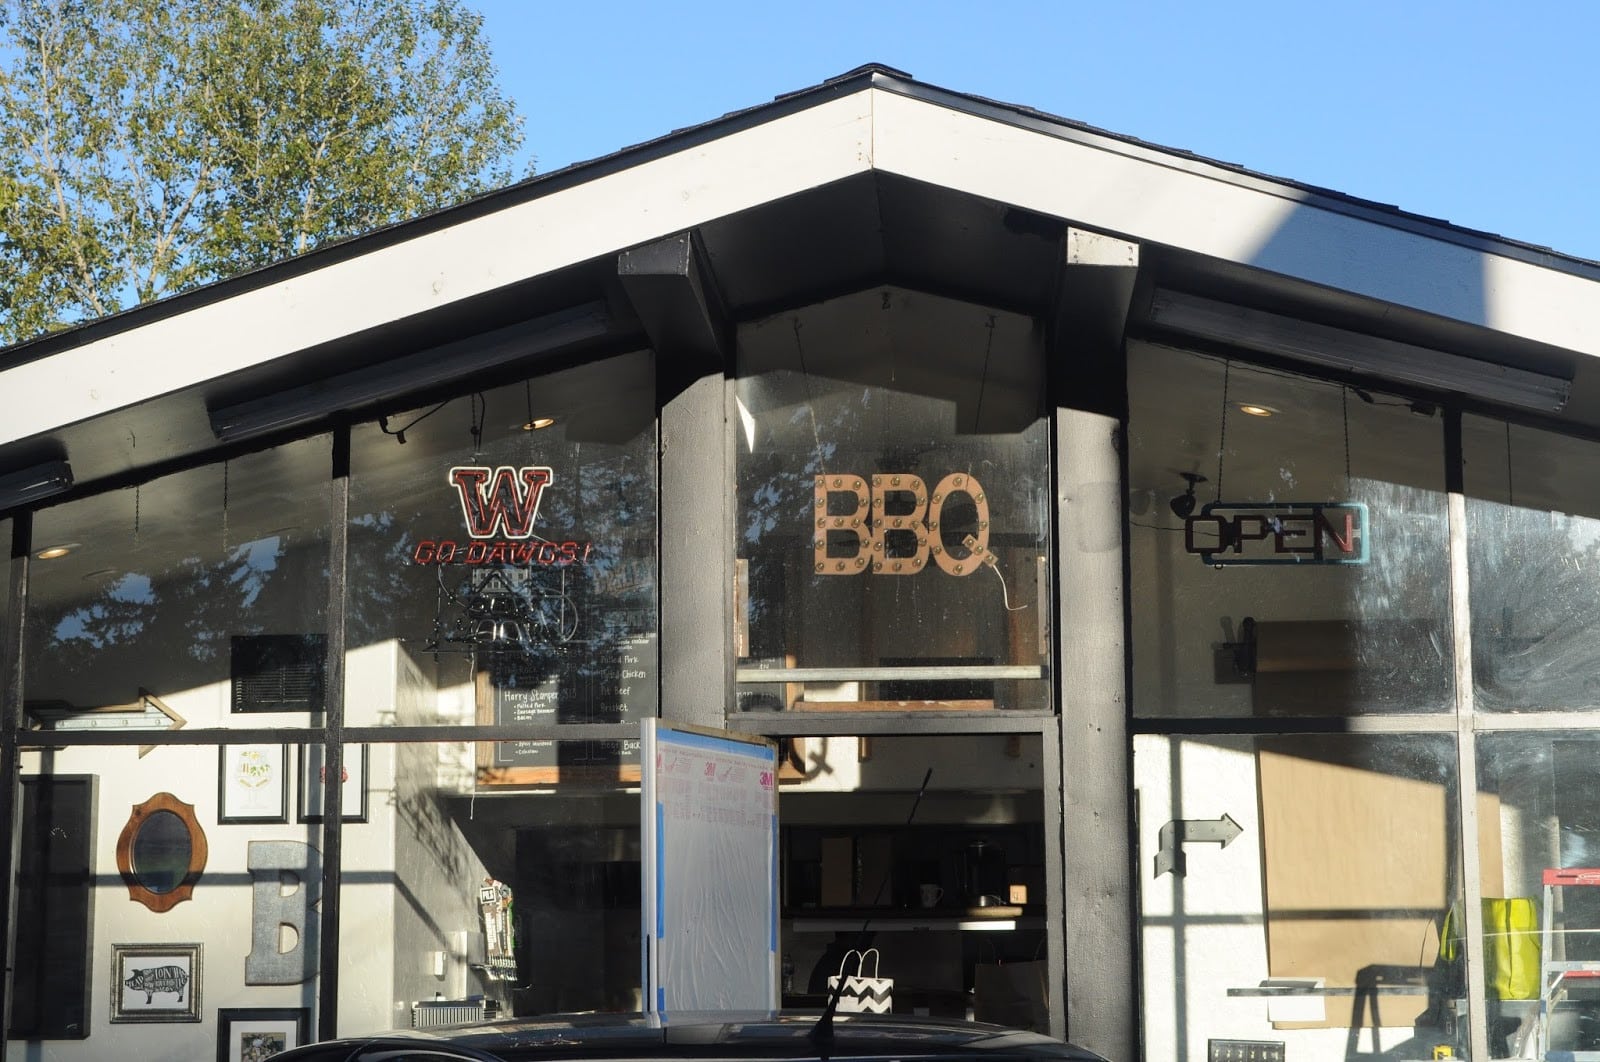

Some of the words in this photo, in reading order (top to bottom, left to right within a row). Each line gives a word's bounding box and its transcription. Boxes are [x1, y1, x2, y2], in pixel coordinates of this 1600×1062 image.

[449, 466, 553, 539] W
[814, 472, 998, 577] BBQ
[1185, 513, 1354, 554] OPEN
[414, 541, 457, 564] GO
[464, 541, 592, 564] DAWGS!
[624, 655, 639, 664] Pork
[622, 669, 647, 679] Chicken
[504, 690, 528, 704] Harry
[614, 686, 631, 696] Beef
[760, 771, 773, 787] 3M
